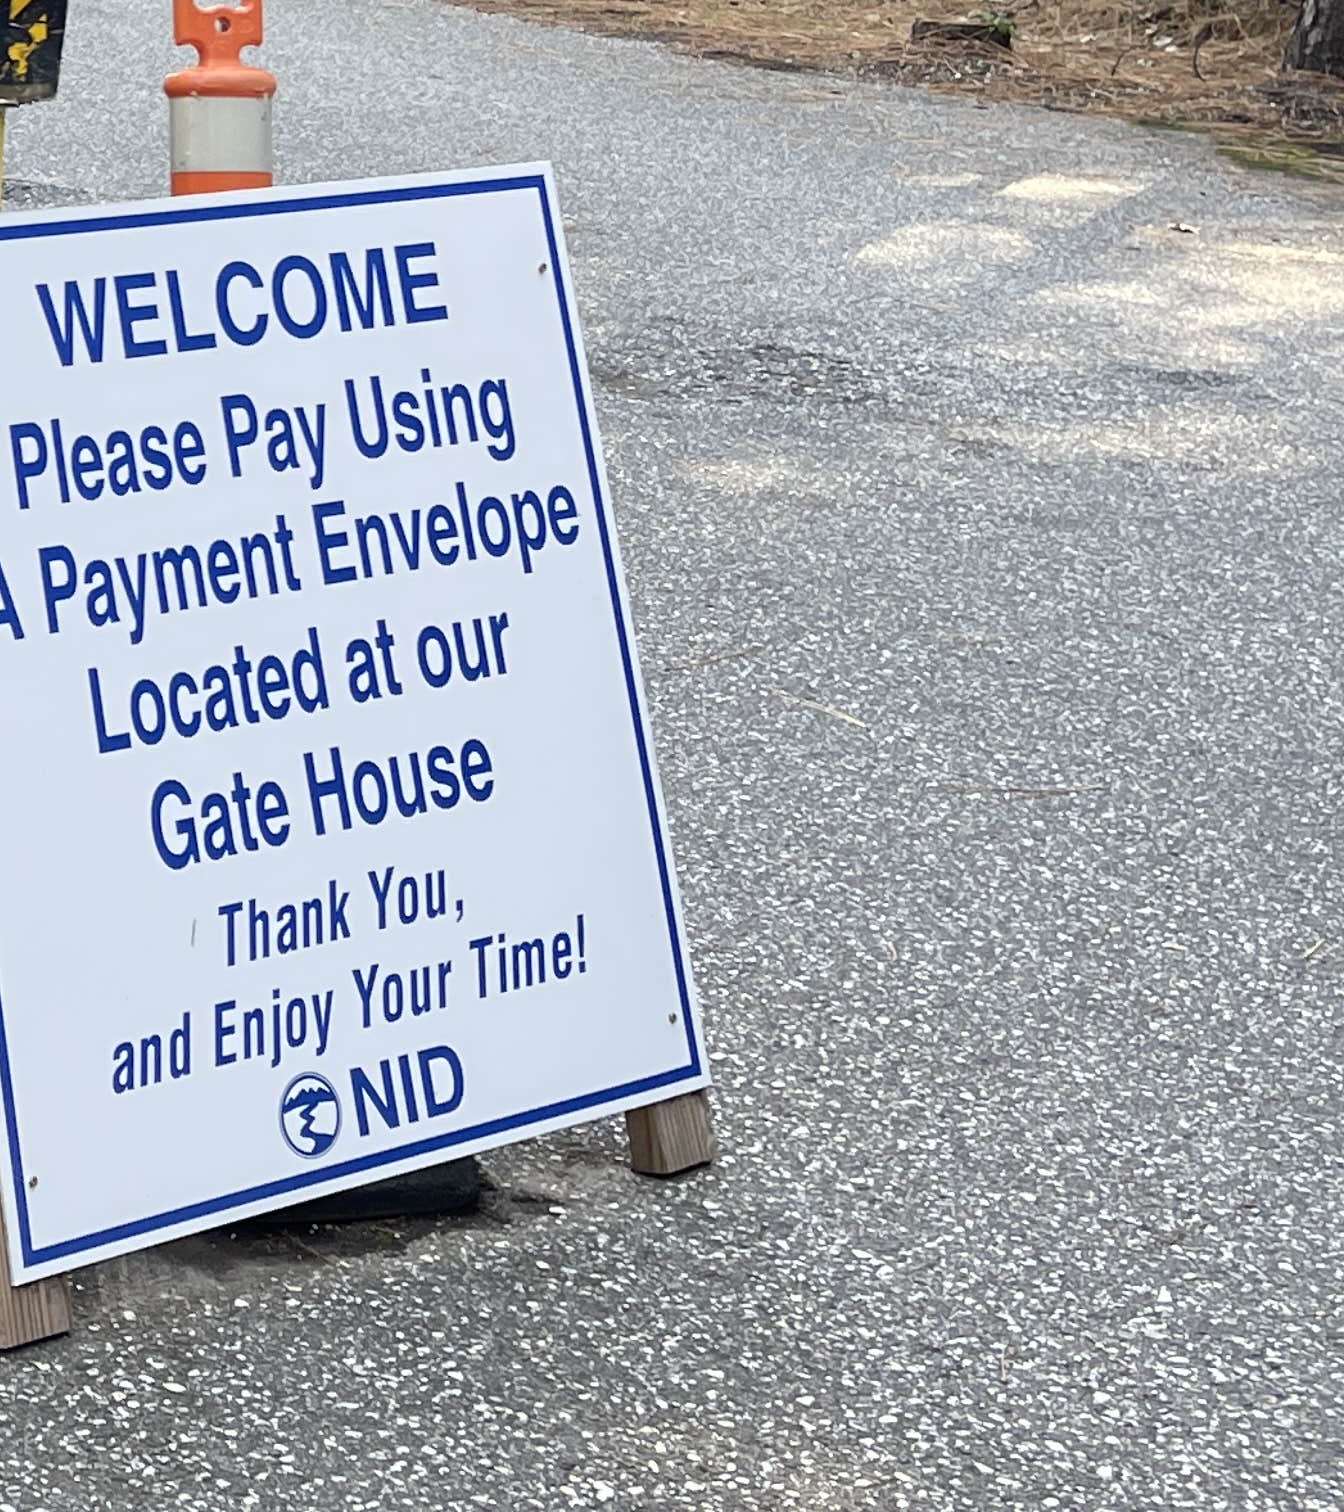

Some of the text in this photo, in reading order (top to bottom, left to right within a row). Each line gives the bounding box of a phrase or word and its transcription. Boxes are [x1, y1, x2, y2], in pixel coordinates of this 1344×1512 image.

[33, 240, 450, 368] WELCOME
[8, 367, 516, 510] Please Pay Using
[37, 513, 302, 645] Payment
[311, 481, 580, 585] Envelope
[87, 612, 509, 754] Located at our
[150, 738, 495, 871] Gate House
[217, 865, 465, 968] Thank You,
[112, 913, 588, 1094] and Enjoy Your Time!
[348, 1043, 466, 1138] NID
